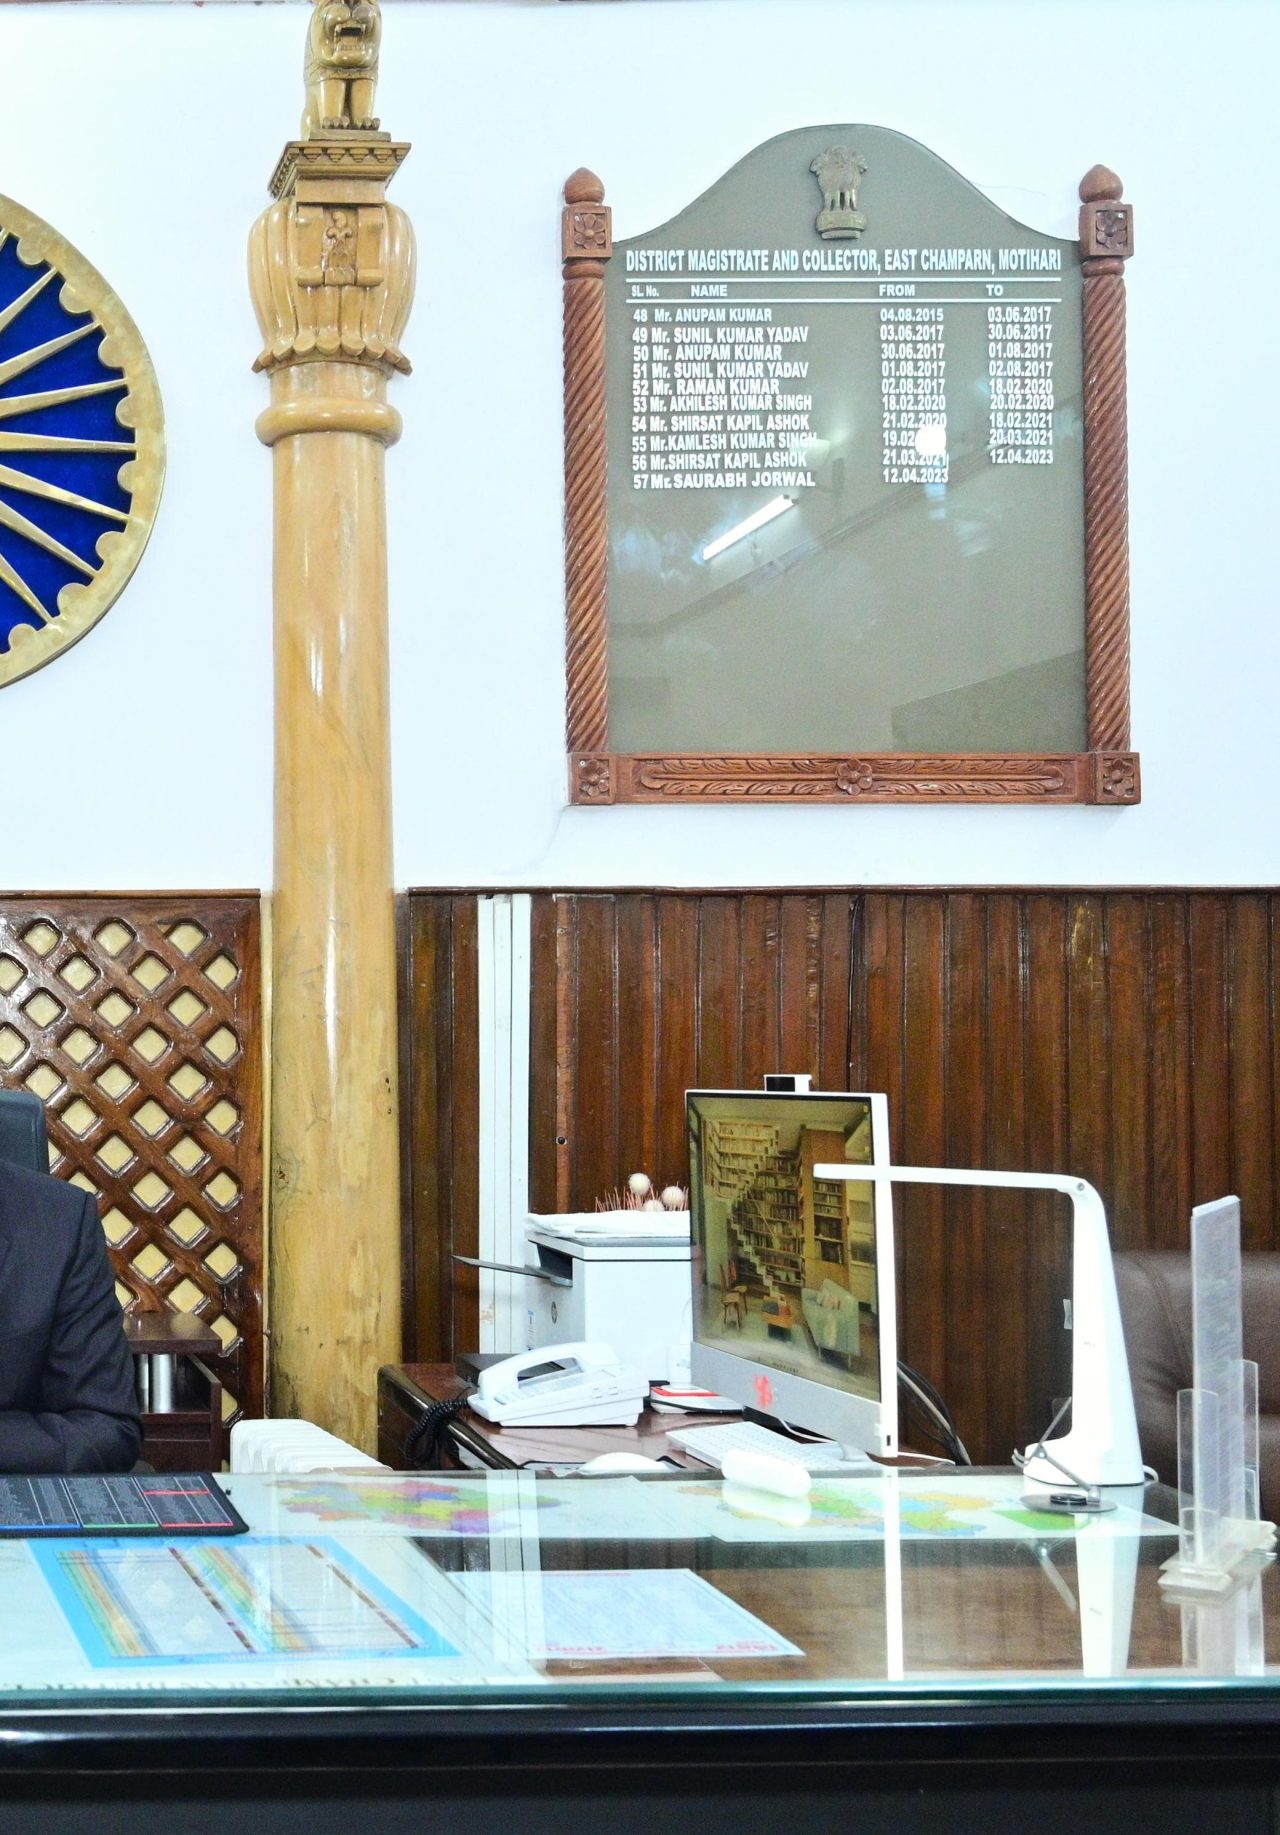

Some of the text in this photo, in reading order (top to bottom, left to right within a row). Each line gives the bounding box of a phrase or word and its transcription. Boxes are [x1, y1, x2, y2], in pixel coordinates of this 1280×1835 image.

[626, 248, 1061, 275] DISTRICT MAGISTRATE AND COLLECTOR, EAST CHAMPARN, MOTIHARI
[690, 284, 727, 296] NAME
[879, 284, 915, 296] FROM
[985, 284, 1003, 296] TO
[633, 306, 1051, 322] 48 Mr. ANUPAM KUMAR 04.08.2015 03.06.2017
[632, 323, 1052, 343] 49 Mr. SUNIL KUMAR YADAV 03.06.2017 30.06.2017
[633, 342, 1052, 361] 50 Mr. ANUPAM KUMAR 30.06.2017 01.08.2017
[632, 360, 1053, 379] 51 Mr. SUNIL KUMAR YADAV 01.08.2017 02.08.2017
[632, 378, 1053, 396] 52 Mr. RAMAN KUMAR 02.08.2017 18.02.2020
[633, 393, 1054, 412] 53 Mr. AKHILESH KUMAR SINGH 18.02.2020 20.02.2020
[631, 412, 1052, 432] 54 Mr. SHIRSAT KAPIL ASHOK 21.02.2020 18.02.2021
[632, 436, 646, 452] 55
[730, 433, 774, 448] KUMAR
[990, 428, 1053, 445] 20.03.2021
[632, 454, 646, 470] 56
[724, 452, 760, 468] KAPIL
[764, 452, 807, 467] ASHOK
[990, 449, 1053, 463] 12.04.2023
[633, 474, 648, 488] 57
[751, 471, 816, 487] JORWAL
[882, 467, 948, 482] 12.04.2023
